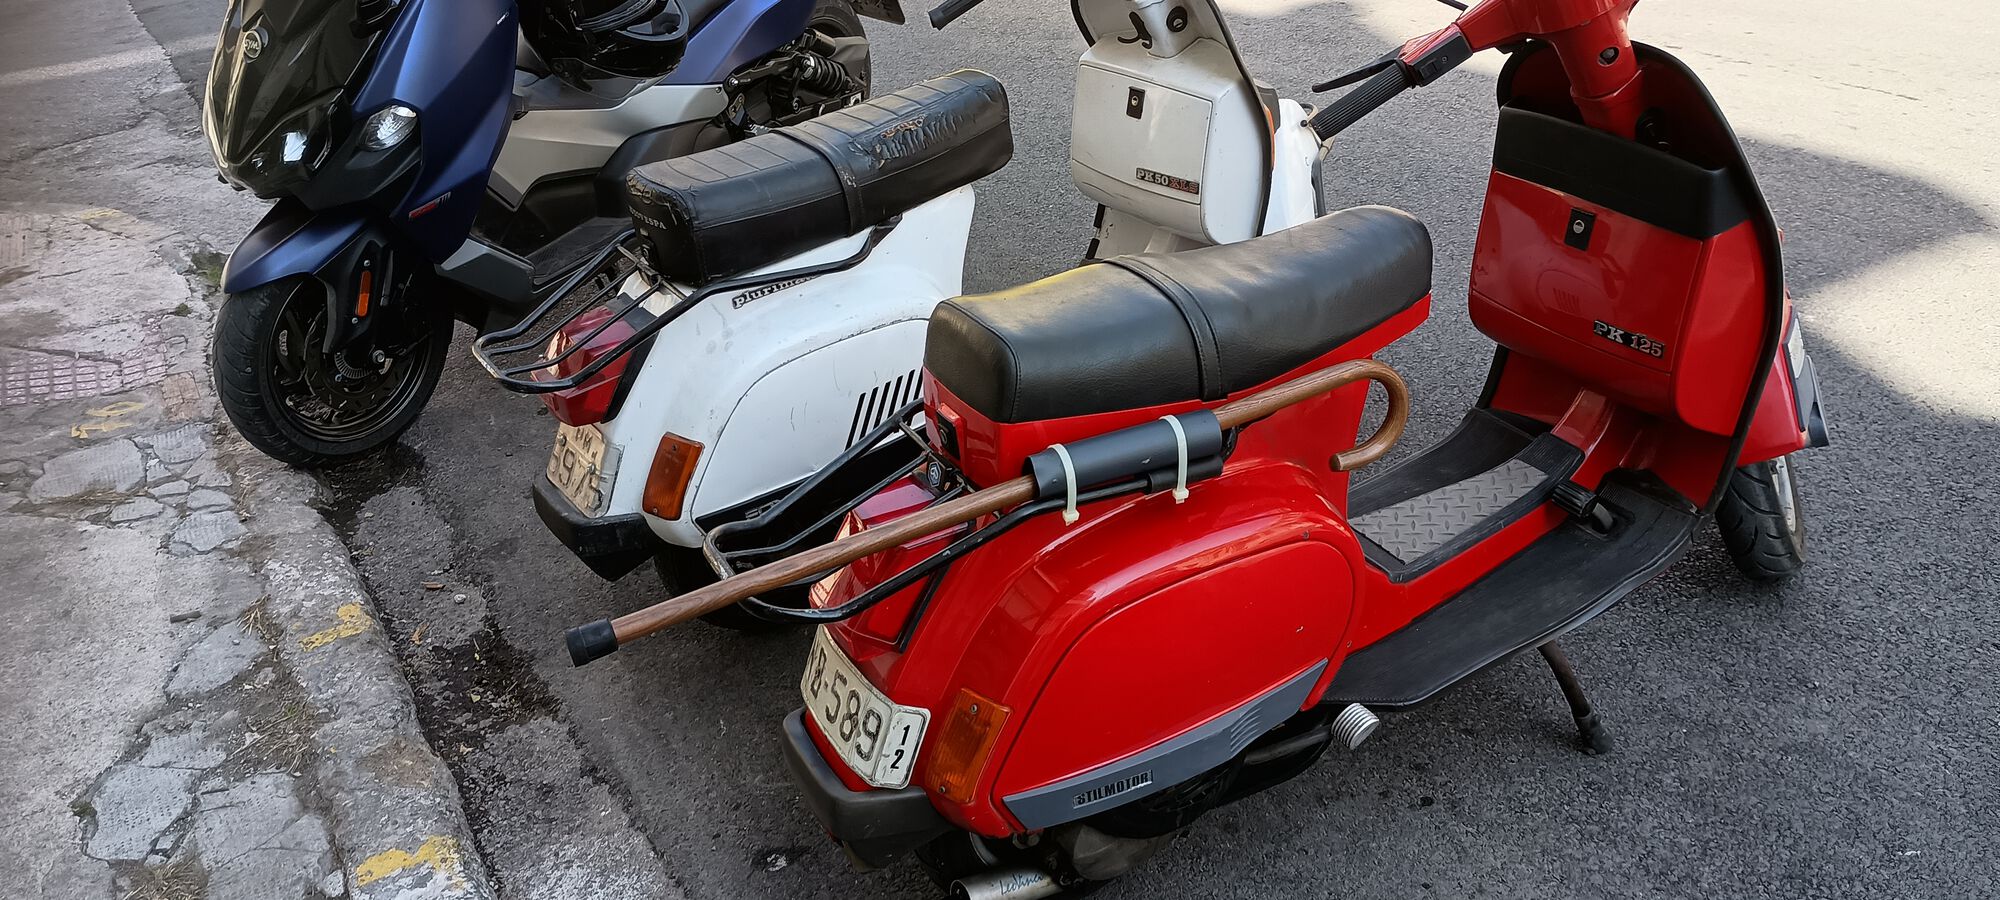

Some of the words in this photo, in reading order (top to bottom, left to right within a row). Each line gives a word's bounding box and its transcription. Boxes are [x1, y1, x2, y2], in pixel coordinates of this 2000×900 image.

[244, 39, 260, 50] SYM
[1594, 320, 1624, 343] PK
[1630, 335, 1662, 357] 125
[1077, 772, 1149, 804] STILMOTOR
